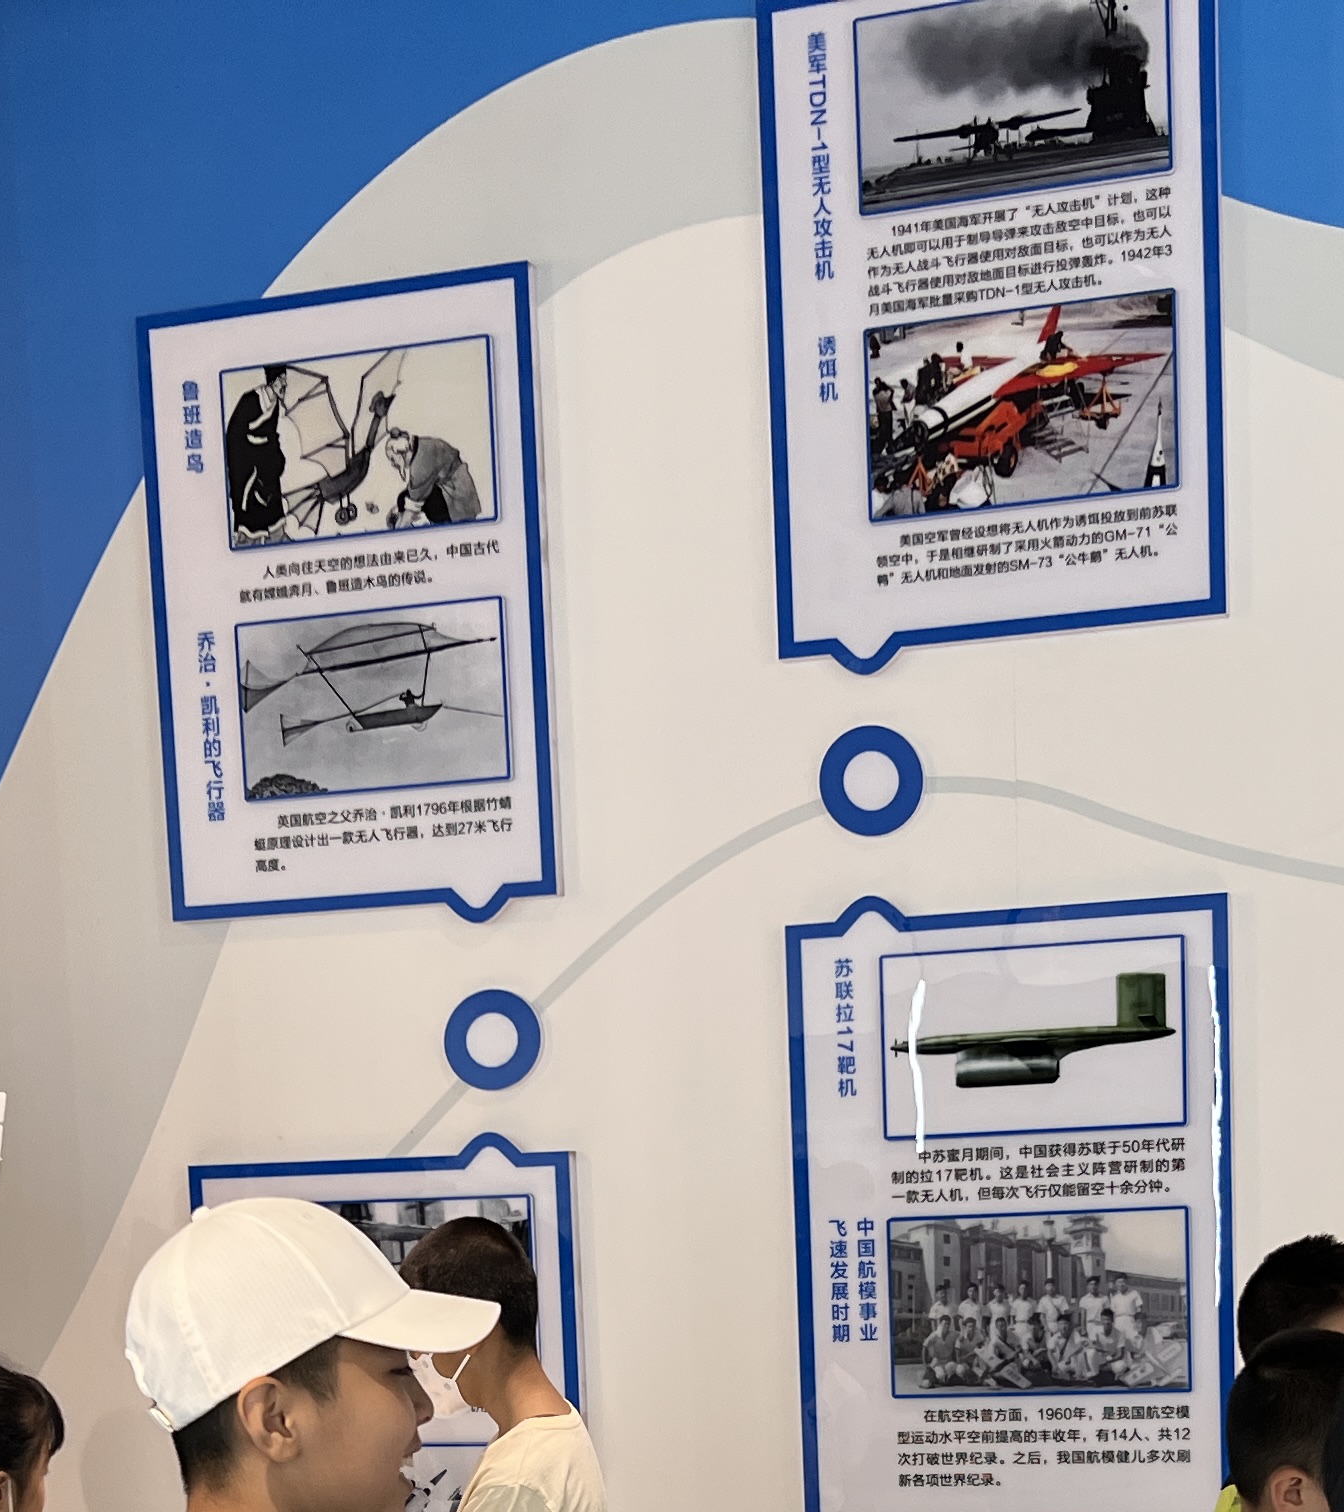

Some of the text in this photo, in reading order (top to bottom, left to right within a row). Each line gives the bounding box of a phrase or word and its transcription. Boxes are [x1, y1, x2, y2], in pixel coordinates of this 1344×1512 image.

[816, 335, 839, 403] 诱饵机
[182, 380, 204, 473] 鲁班造鸟
[834, 957, 857, 1098] 苏联拉17靶机
[919, 1137, 1186, 1163] 中苏蜜月期间，中国获得苏联于50年代研
[891, 1157, 1186, 1186] 制的拉17靶机。这是社会主义阵营研制的第
[891, 1180, 1171, 1205] 一款无人机，但每次飞行仅能留空十余分钟。
[829, 1219, 851, 1344] 飞速发展时期
[857, 1218, 878, 1342] 中国航模事业
[923, 1405, 1190, 1424] 在航空科普方面，1960年，是我国航空模
[896, 1427, 1191, 1446] 型运动水平空前提高的丰收年，有14人、共12
[896, 1448, 1191, 1467] 次打破世界纪录。之后，我国航模健儿多次刷
[898, 1473, 1002, 1488] 新各项世界纪录。
